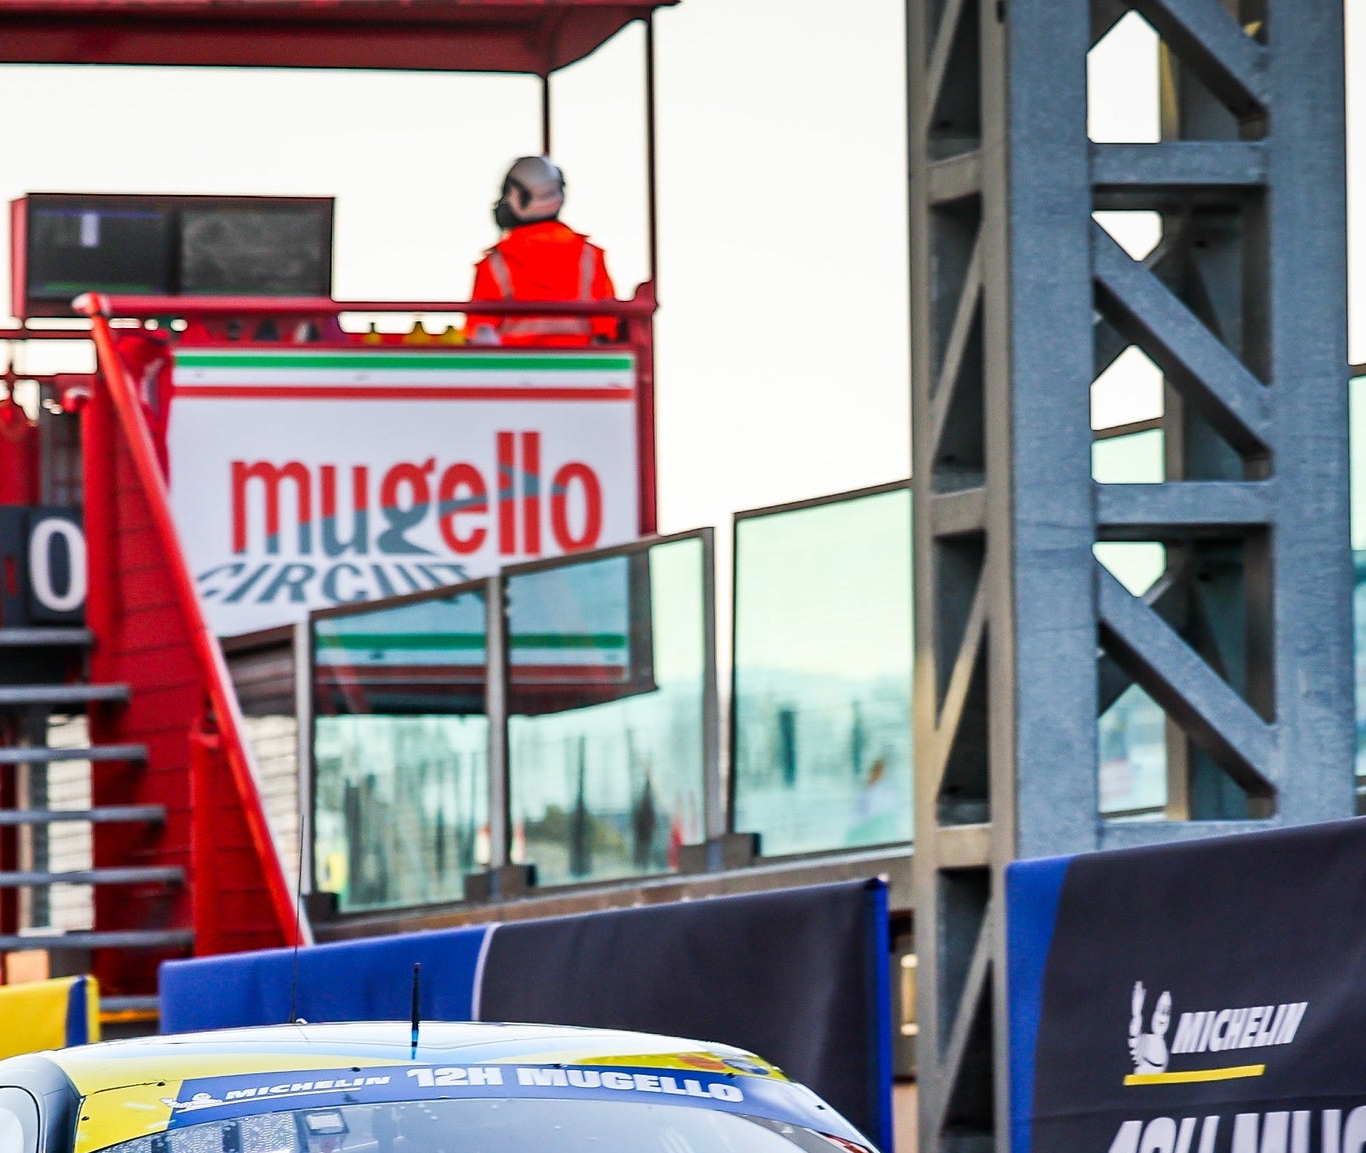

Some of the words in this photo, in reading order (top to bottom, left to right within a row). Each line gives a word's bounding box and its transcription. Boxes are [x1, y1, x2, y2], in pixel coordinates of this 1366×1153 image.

[231, 430, 604, 557] mugello
[1170, 1001, 1309, 1055] MICHELIN
[224, 1075, 392, 1100] MICHELIN
[406, 1067, 503, 1088] 12H
[516, 1067, 744, 1103] MUGELLO
